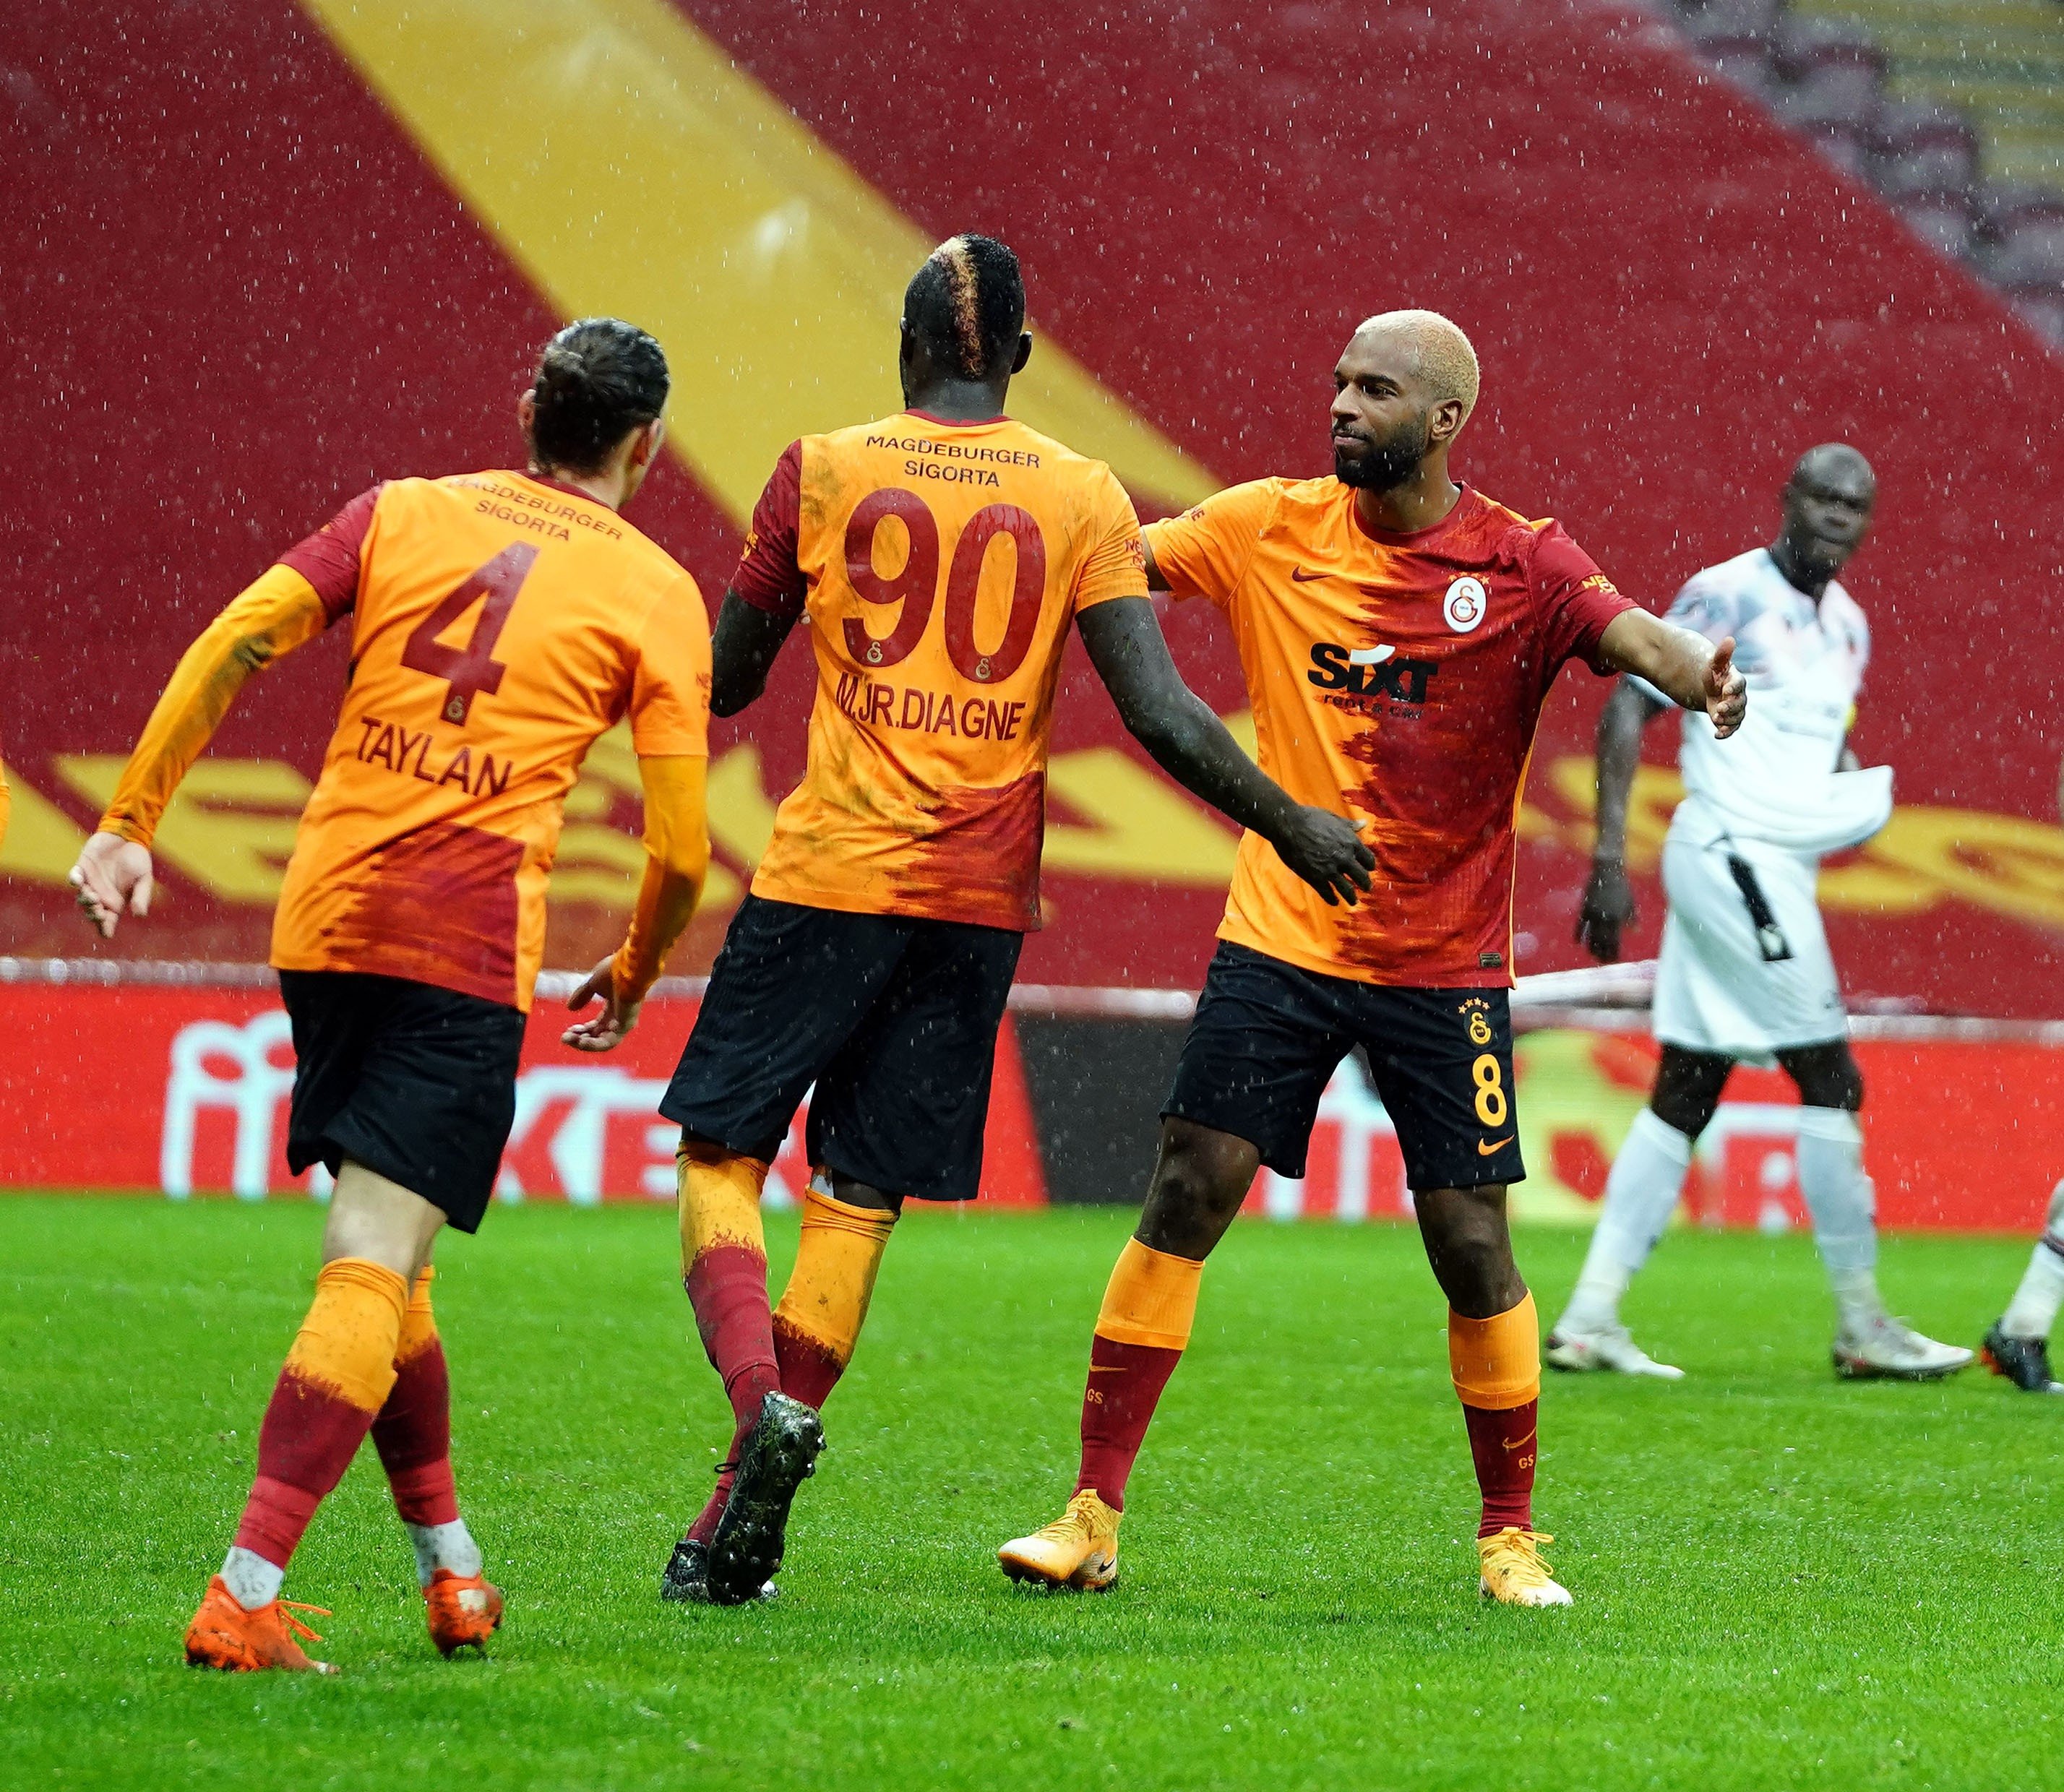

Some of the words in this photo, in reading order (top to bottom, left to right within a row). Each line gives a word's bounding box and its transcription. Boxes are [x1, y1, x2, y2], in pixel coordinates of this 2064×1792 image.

[867, 436, 1040, 468] MAGDEBURGER
[904, 458, 1000, 487] SİGORTA
[474, 499, 570, 541] SİGORTA
[843, 487, 1046, 684] 90
[400, 540, 540, 726] 4
[357, 715, 514, 796] TAYLAN
[1472, 1054, 1507, 1127] 8
[1087, 1388, 1104, 1405] GS
[1518, 1454, 1534, 1469] GS
